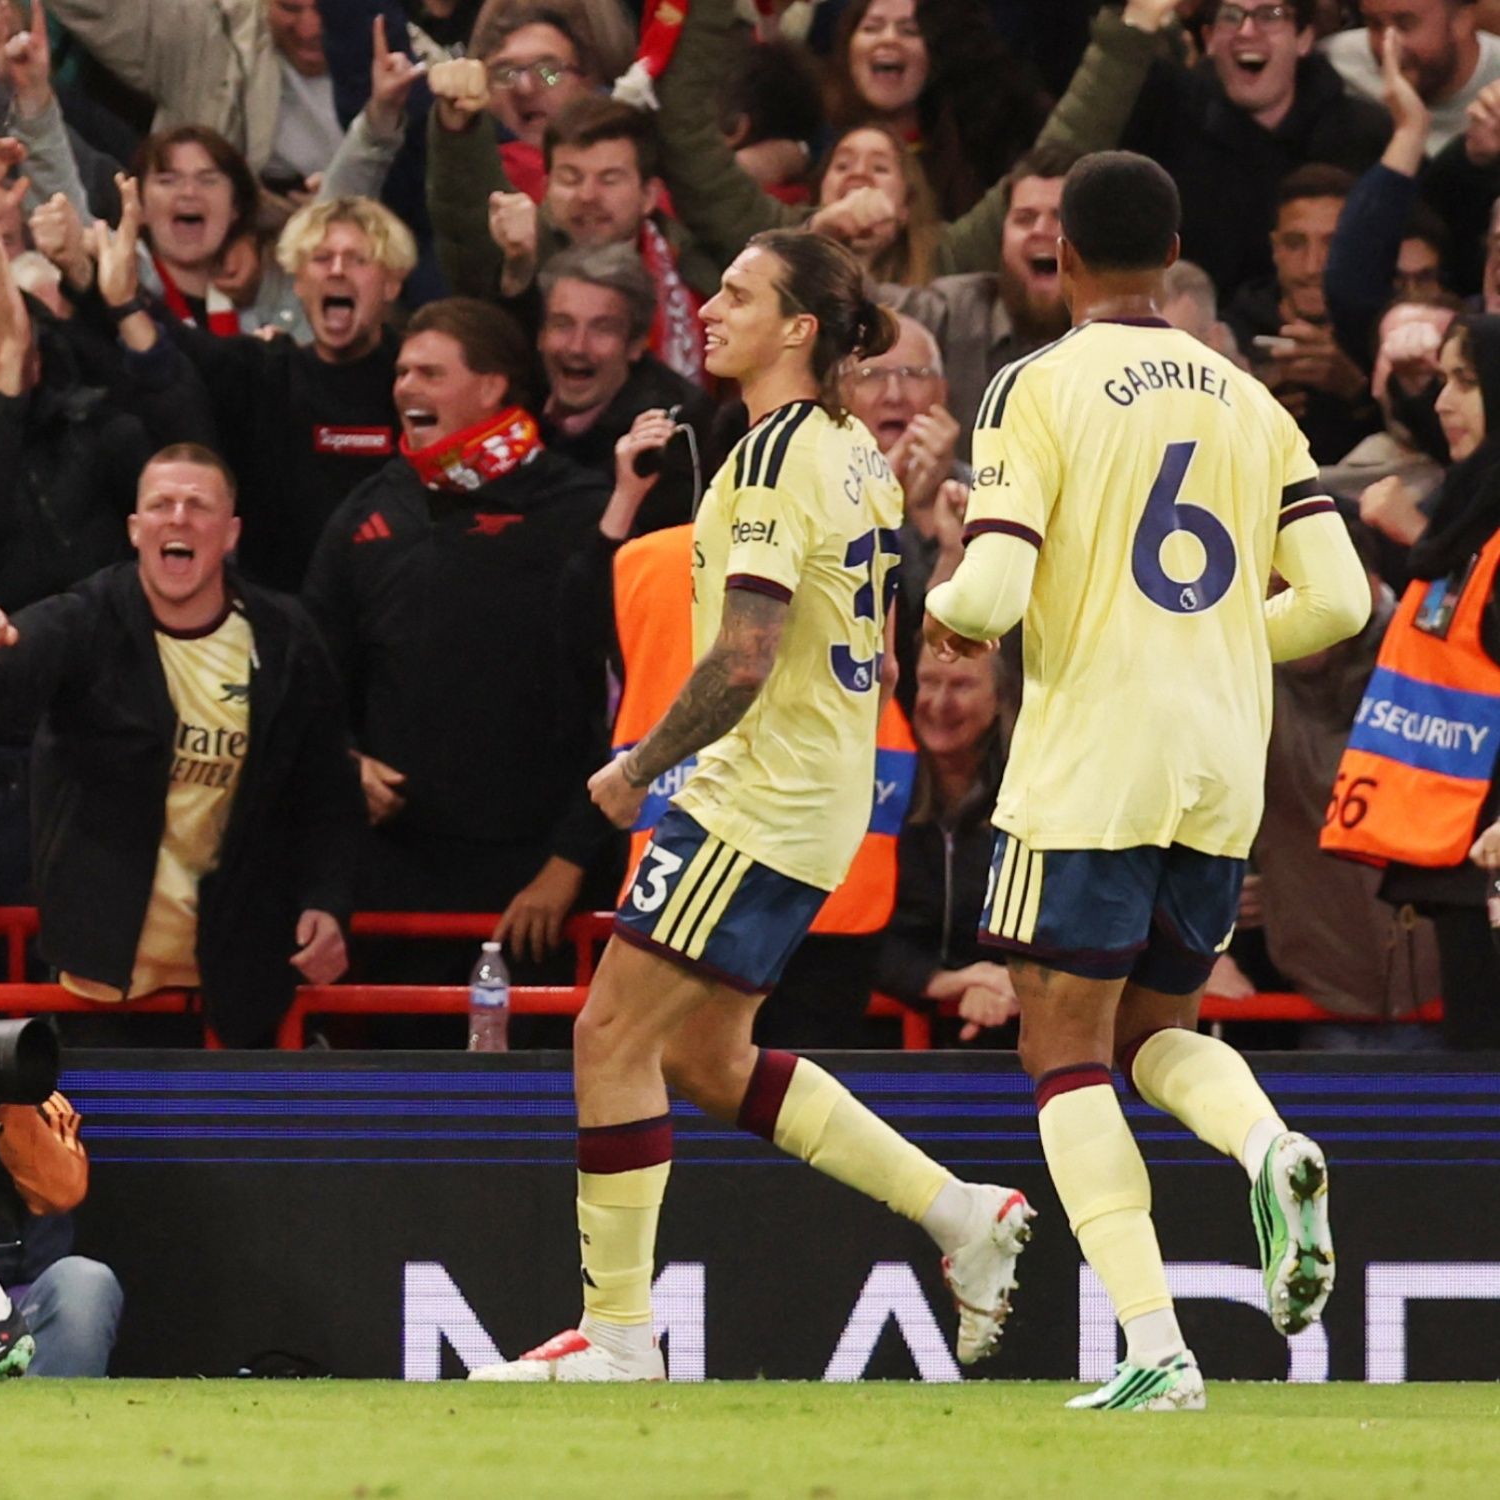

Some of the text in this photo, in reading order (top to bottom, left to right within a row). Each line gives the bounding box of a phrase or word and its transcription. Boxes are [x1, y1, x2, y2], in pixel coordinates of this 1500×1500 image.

[1104, 361, 1231, 406] GABRIEL
[320, 427, 386, 450] Supreme
[731, 517, 780, 547] deel.
[1131, 440, 1237, 613] 6
[1367, 699, 1489, 755] SECURITY
